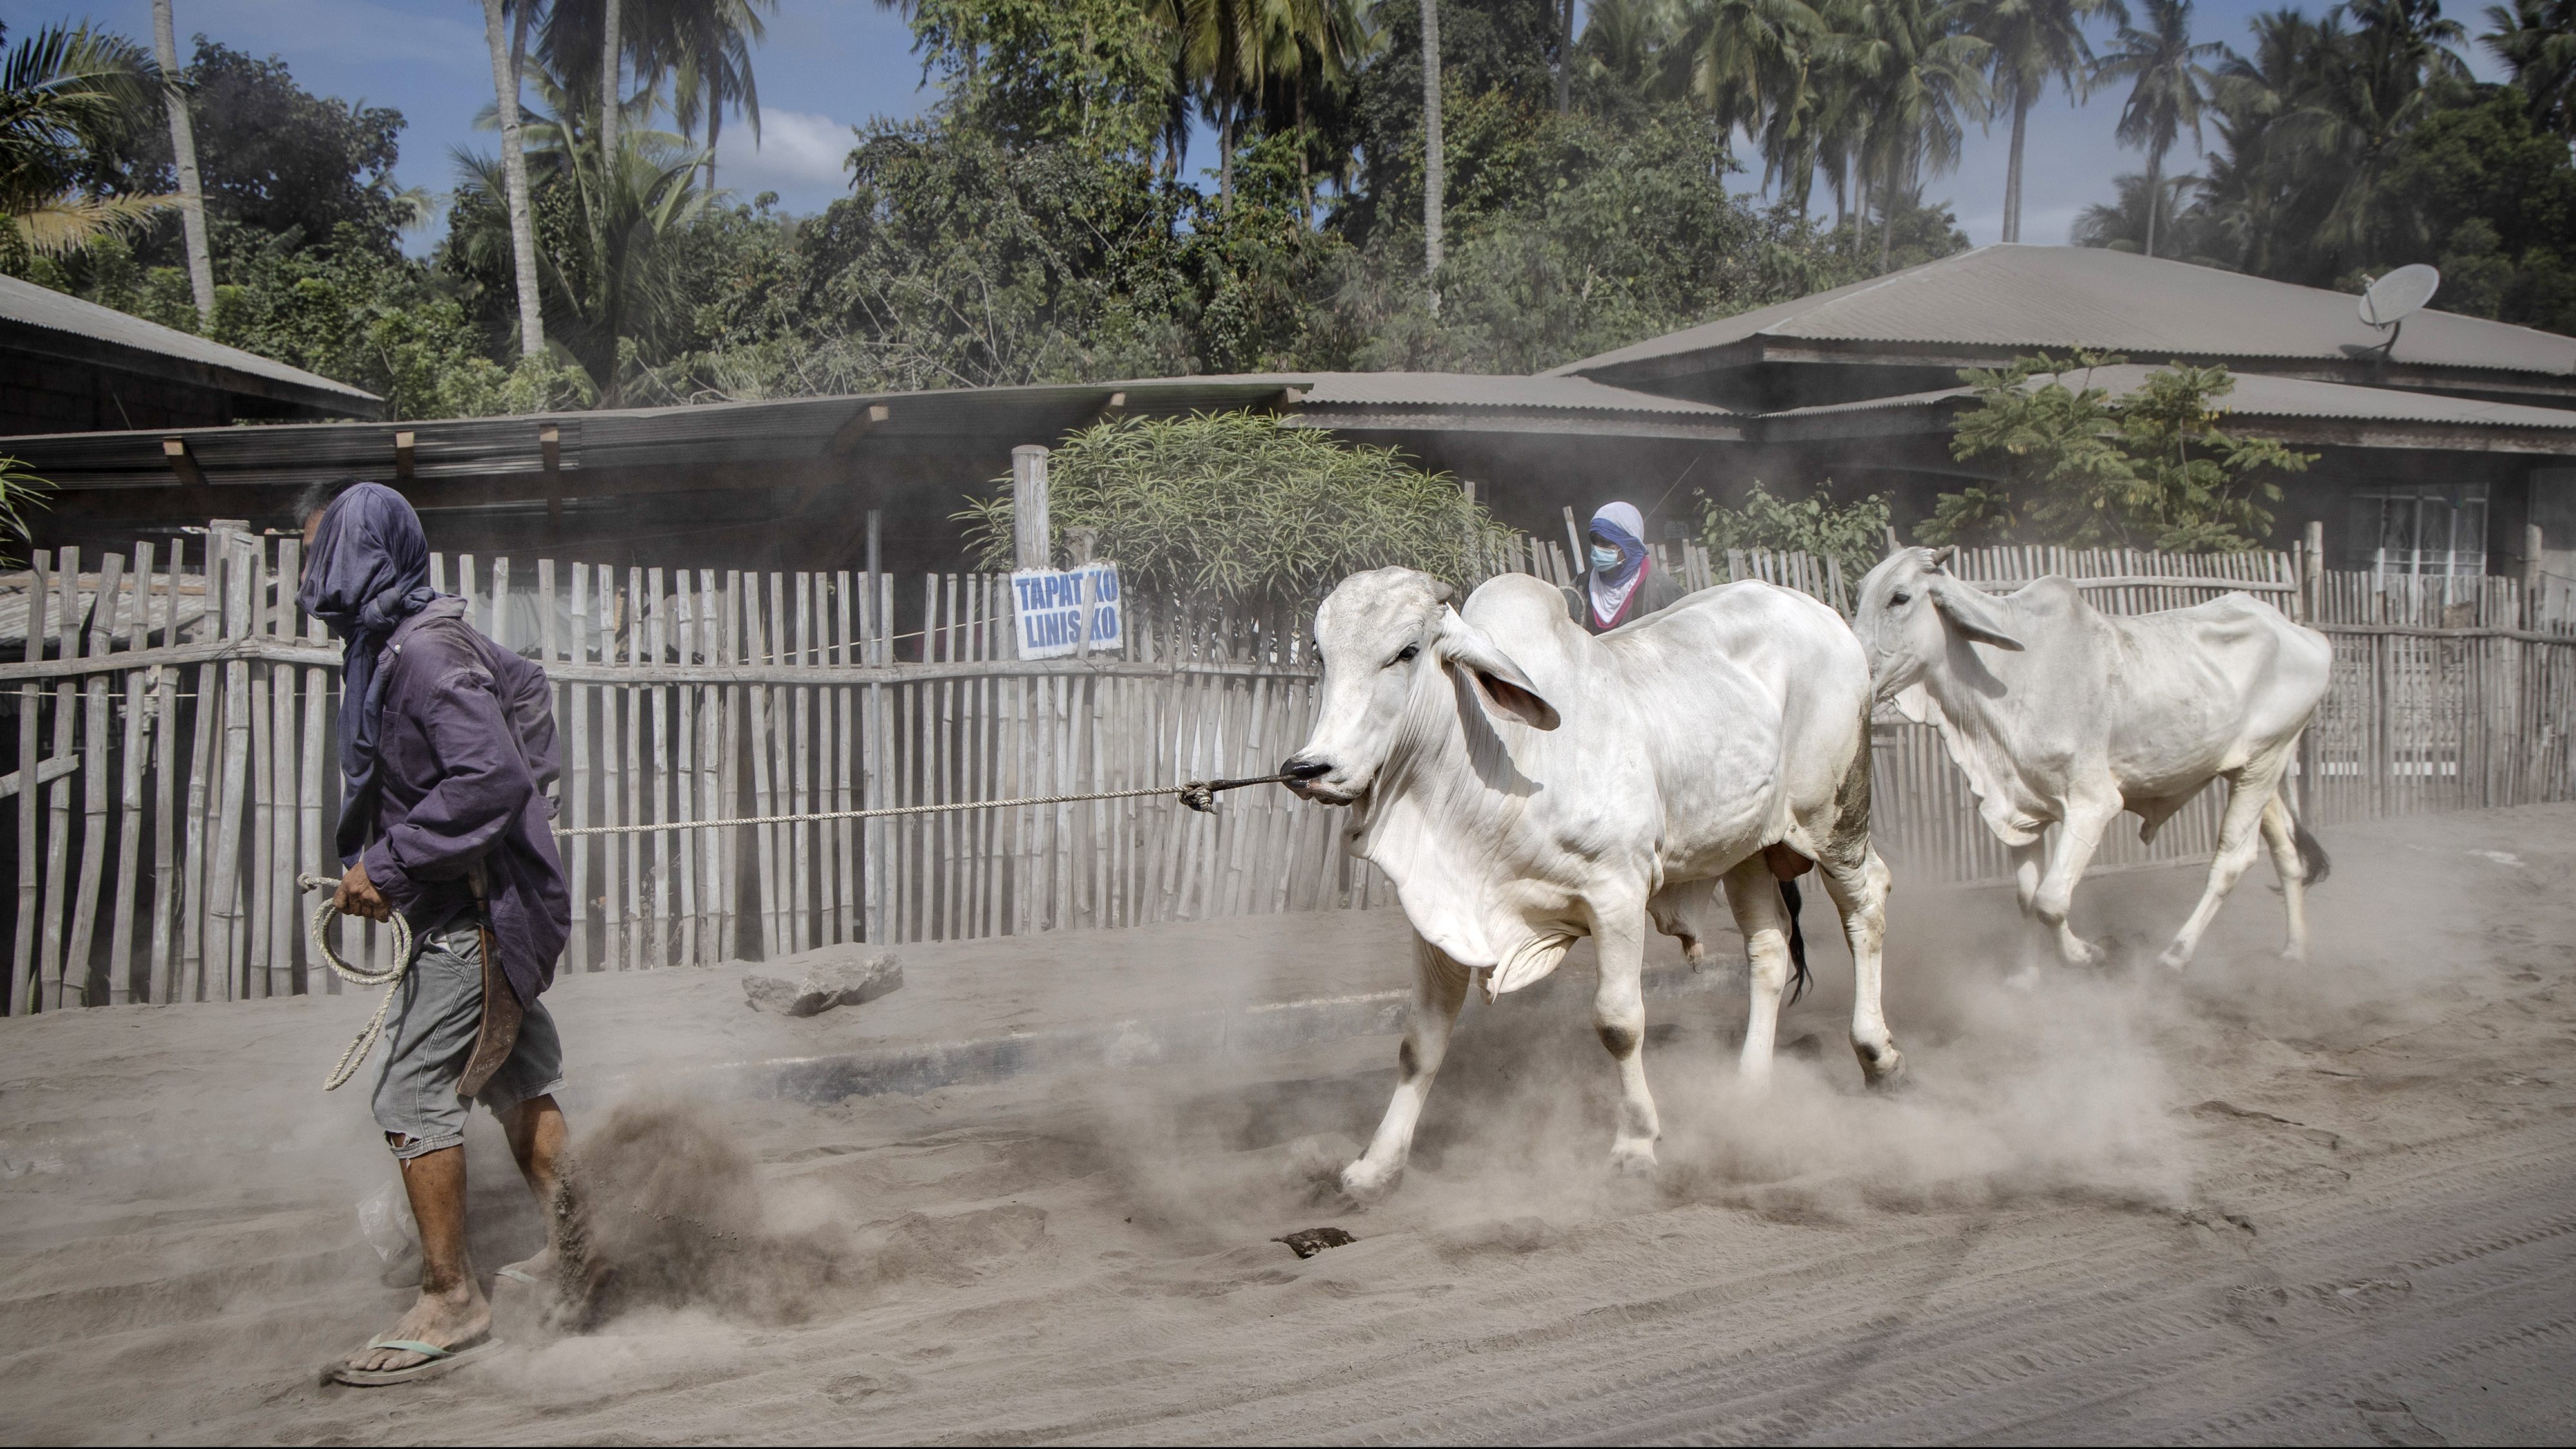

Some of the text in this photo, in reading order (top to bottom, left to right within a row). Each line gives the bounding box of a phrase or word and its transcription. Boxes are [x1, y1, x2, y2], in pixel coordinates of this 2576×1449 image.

[1016, 569, 1118, 611] TAPAT KO
[1025, 606, 1116, 648] LINIS KO
